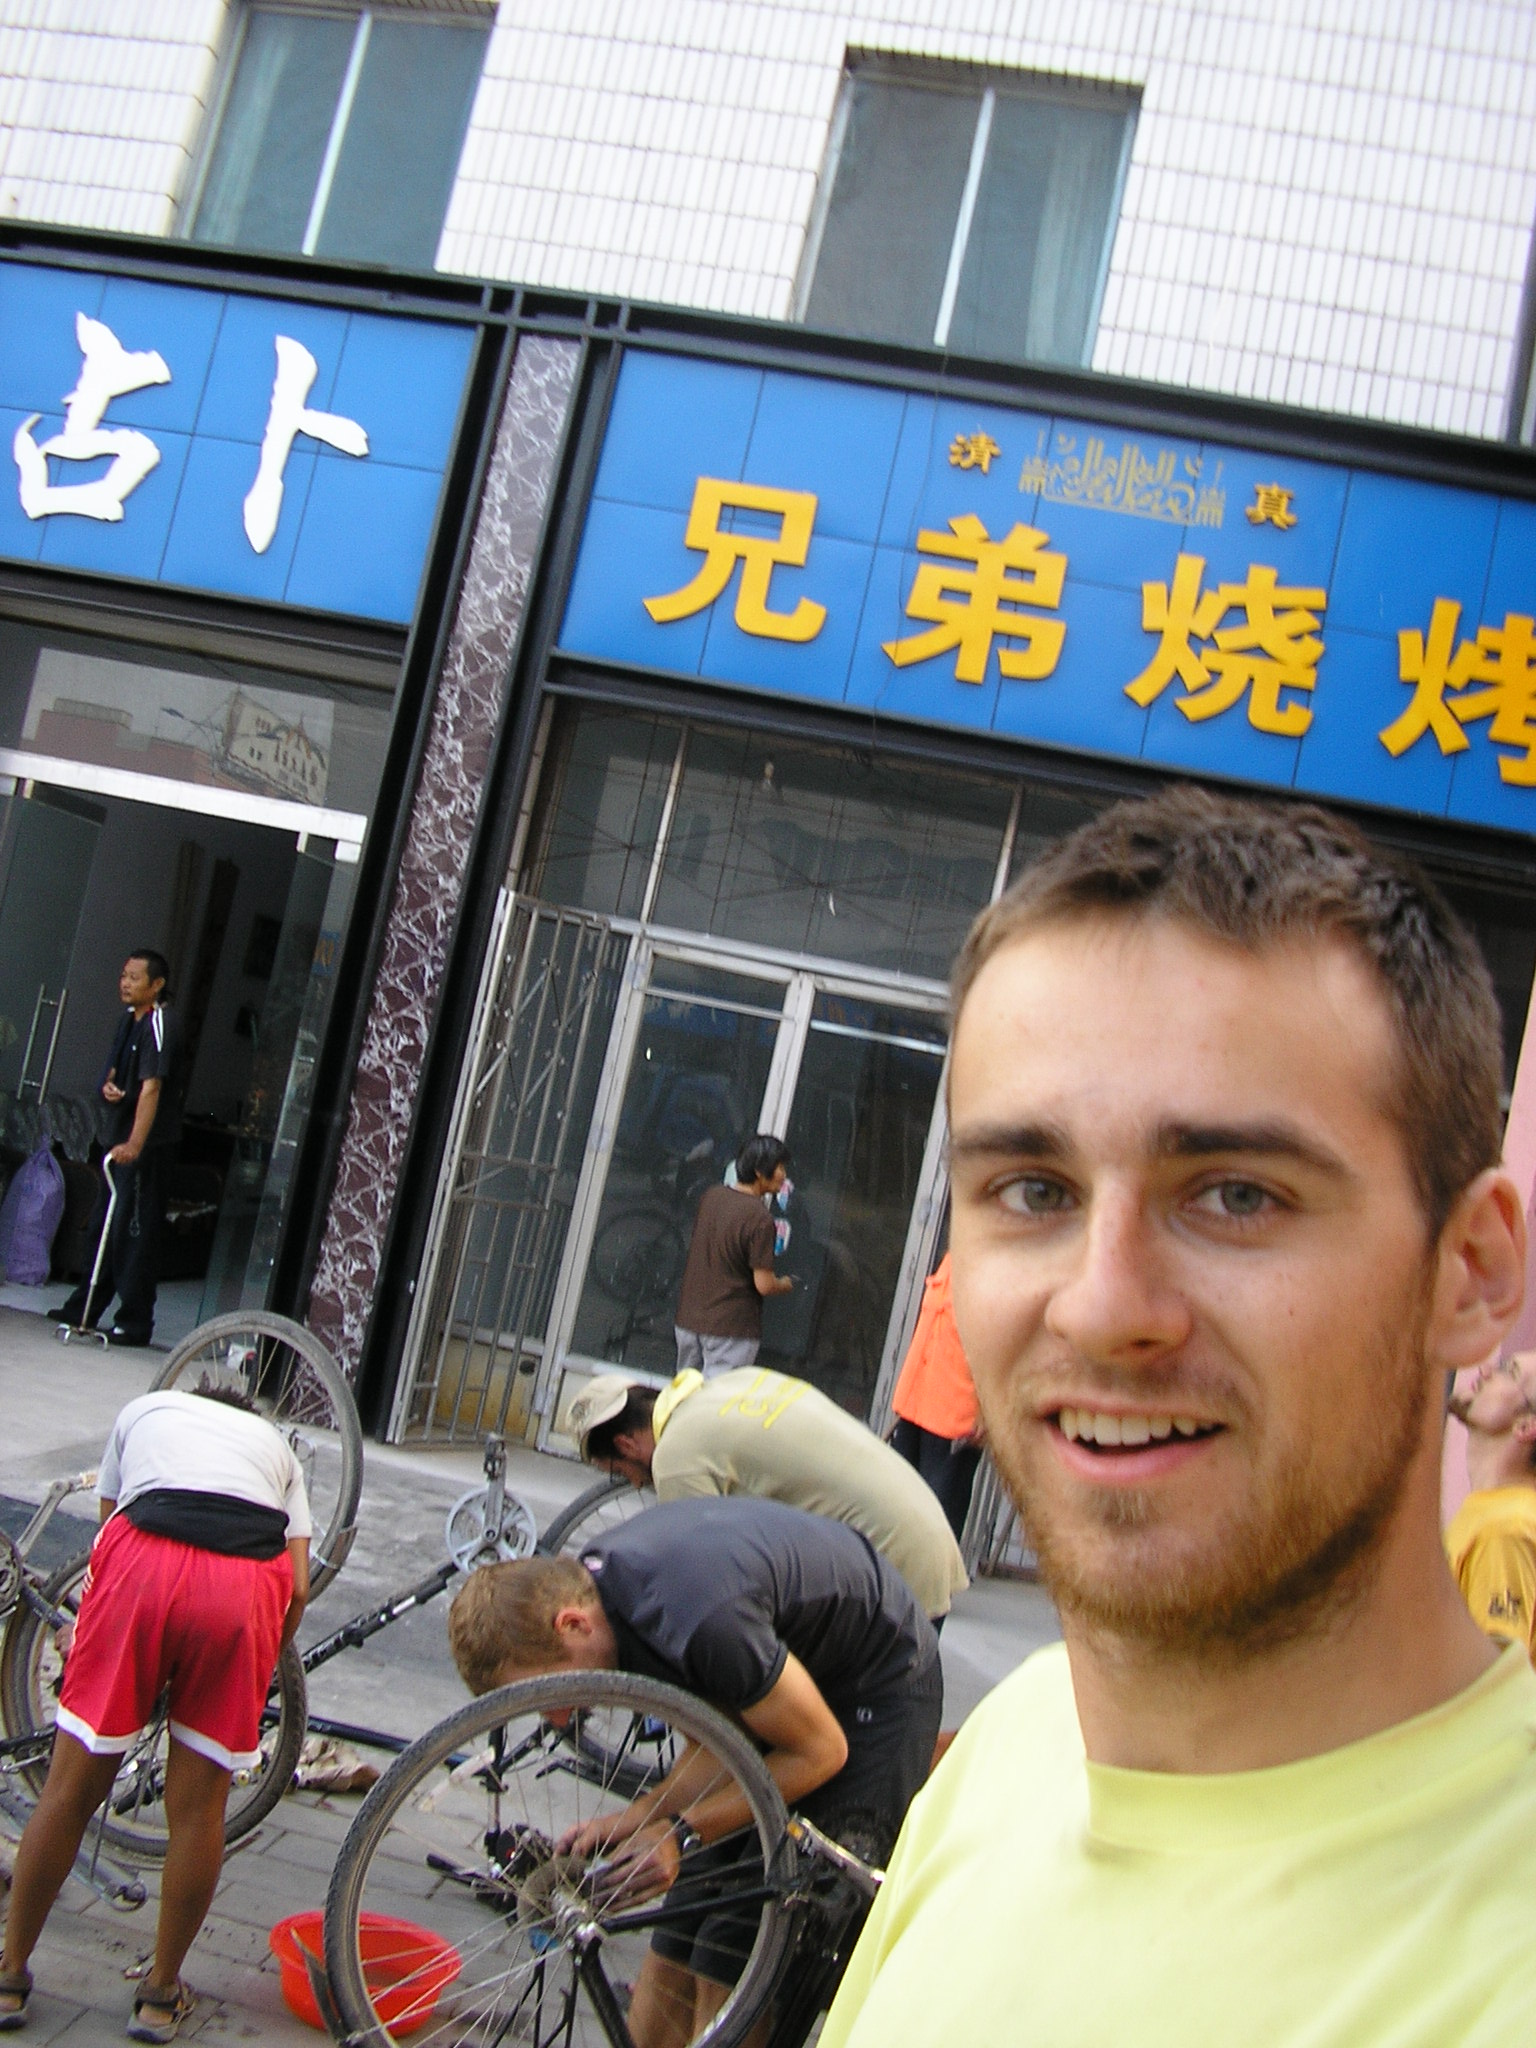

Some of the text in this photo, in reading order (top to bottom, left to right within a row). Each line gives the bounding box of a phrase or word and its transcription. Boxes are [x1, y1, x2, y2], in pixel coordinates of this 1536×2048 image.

[14, 311, 370, 554] 占卜
[949, 432, 1297, 530] 清 真
[643, 476, 1536, 787] 兄弟烧烤
